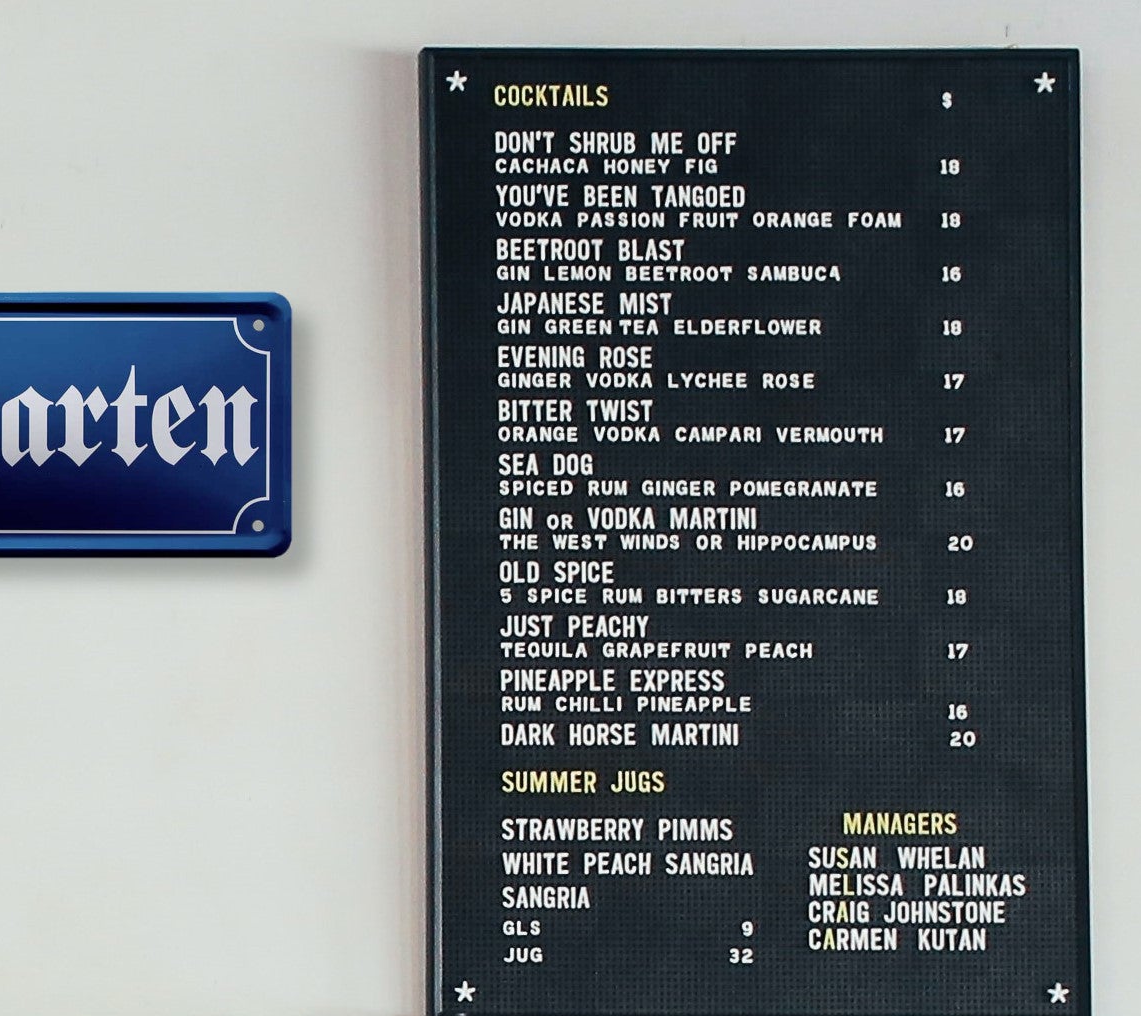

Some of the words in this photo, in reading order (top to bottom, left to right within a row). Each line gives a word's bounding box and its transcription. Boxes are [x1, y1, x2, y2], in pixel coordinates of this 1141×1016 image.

[494, 84, 609, 107] COCKTAILS
[494, 130, 555, 154] DON'T
[569, 131, 636, 155] SHRUB
[650, 131, 684, 155] ME
[697, 131, 737, 155] OFF
[495, 157, 589, 175] CACHACA
[603, 158, 671, 175] HONEY
[685, 158, 718, 175] FIG
[940, 158, 960, 176] 18
[495, 183, 569, 208] YOU'VE
[583, 184, 638, 208] BEEN
[650, 184, 746, 209] TANGOED
[495, 211, 563, 228] VODKA
[577, 211, 665, 229] PASSION
[679, 211, 739, 229] FRUIT
[752, 211, 833, 229] ORANGE
[847, 211, 902, 229] FOAM
[941, 212, 961, 229] 18
[496, 237, 604, 262] BEETROOT
[618, 238, 685, 262] BLAST
[496, 264, 530, 282] GIN
[544, 265, 612, 282] LEMON
[625, 265, 733, 282] BEETROOT
[941, 265, 962, 283] 16
[496, 291, 605, 315] JAPANESE
[619, 292, 673, 316] MIST
[497, 318, 531, 335] GIN
[544, 318, 615, 336] GREEN
[617, 318, 659, 336] TEA
[673, 318, 822, 336] ELDERFLOWER
[942, 319, 963, 336] 18
[497, 345, 585, 369] EVENING
[599, 345, 653, 370] ROSE
[497, 372, 572, 389] GINGER
[585, 372, 653, 389] VODKA
[667, 372, 748, 389] LYCHEE
[762, 372, 815, 390] ROSE
[943, 373, 965, 390] 17
[497, 398, 573, 423] BITTER
[585, 399, 654, 423] TWIST
[497, 425, 579, 443] ORANGE
[593, 425, 661, 443] VODKA
[674, 426, 762, 443] CAMPARI
[775, 426, 884, 444] VERMOUTH
[944, 427, 966, 444] 17
[498, 452, 539, 477] SEA
[552, 453, 594, 476] DOG
[499, 479, 574, 497] SPICED
[587, 479, 628, 497] RUM
[641, 479, 716, 497] GINGER
[729, 480, 878, 498] POMEGRANATE
[945, 480, 966, 498] 16
[499, 506, 533, 530] GIN
[546, 513, 574, 531] OR
[586, 506, 656, 531] VODKA
[669, 506, 757, 531] MARTINI
[499, 533, 539, 551] THE
[552, 533, 608, 551] WEST
[619, 533, 680, 551] WINDS
[695, 534, 723, 551] OR
[737, 534, 877, 552] HIPPOCAMPUS
[947, 535, 974, 552] 20
[499, 560, 540, 584] OLD
[553, 560, 615, 584] SPICE
[499, 587, 512, 604] 5
[527, 587, 587, 605] SPICE
[602, 587, 643, 605] RUM
[656, 587, 743, 605] BITTERS
[758, 588, 879, 606] SUGARCANE
[946, 588, 967, 606] 18
[499, 614, 554, 638] JUST
[567, 614, 650, 639] PEACHY
[500, 641, 588, 659] TEQUILA
[602, 641, 731, 659] GRAPEFRUIT
[745, 642, 813, 659] PEACH
[947, 642, 969, 660] 17
[500, 668, 616, 693] PINEAPPLE
[630, 669, 725, 693] EXPRESS
[501, 695, 542, 712] RUM
[555, 695, 623, 713] CHILLI
[637, 695, 752, 713] PINEAPPLE
[947, 703, 968, 721] 16
[501, 722, 556, 747] DARK
[569, 722, 637, 747] HORSE
[651, 722, 739, 747] MARTINI
[949, 730, 977, 748] 20
[501, 770, 597, 794] SUMMER
[610, 770, 665, 793] JUGS
[501, 817, 644, 842] STRAWBERRY
[658, 817, 734, 842] PIMMS
[843, 812, 958, 836] MANAGERS
[501, 851, 570, 876] WHITE
[583, 851, 652, 876] PEACH
[664, 852, 754, 876] SANGRIA
[808, 845, 877, 870] SUSAN
[897, 845, 985, 870] WHELAN
[502, 885, 591, 910] SANGRIA
[809, 872, 904, 897] MELISSA
[924, 873, 1027, 898] PALINKAS
[808, 900, 870, 924] CRAIG
[883, 900, 1006, 925] JOHNSTONE
[502, 919, 541, 936] GLS
[741, 920, 754, 937] 9
[808, 927, 898, 951] CARMEN
[917, 927, 987, 952] KUTAN
[503, 946, 543, 964] JUG
[729, 947, 754, 964] 32
